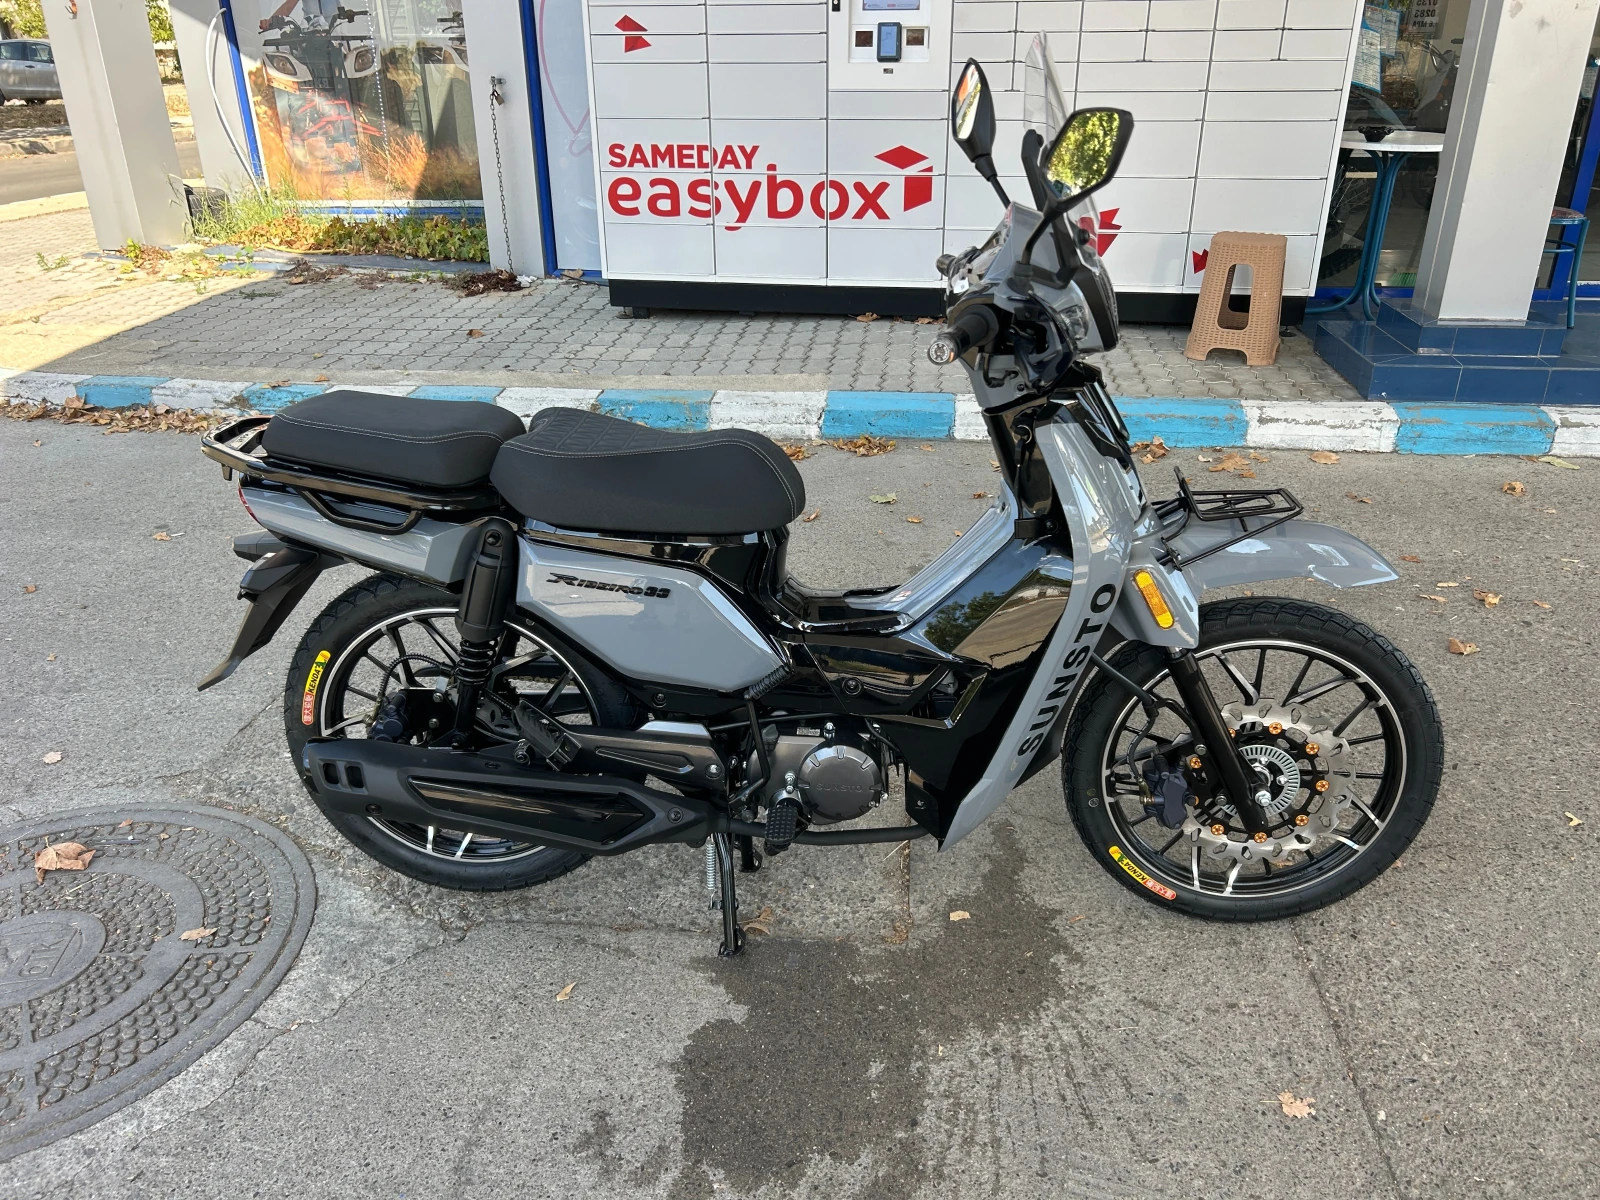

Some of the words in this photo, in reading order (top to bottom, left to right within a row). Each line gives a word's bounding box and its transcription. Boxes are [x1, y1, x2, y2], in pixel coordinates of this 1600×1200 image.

[608, 143, 760, 170] SAMEDAY
[607, 163, 891, 232] easybox
[307, 669, 321, 694] KENDA
[1017, 583, 1117, 757] SUNSTO
[1123, 861, 1148, 882] KENDA
